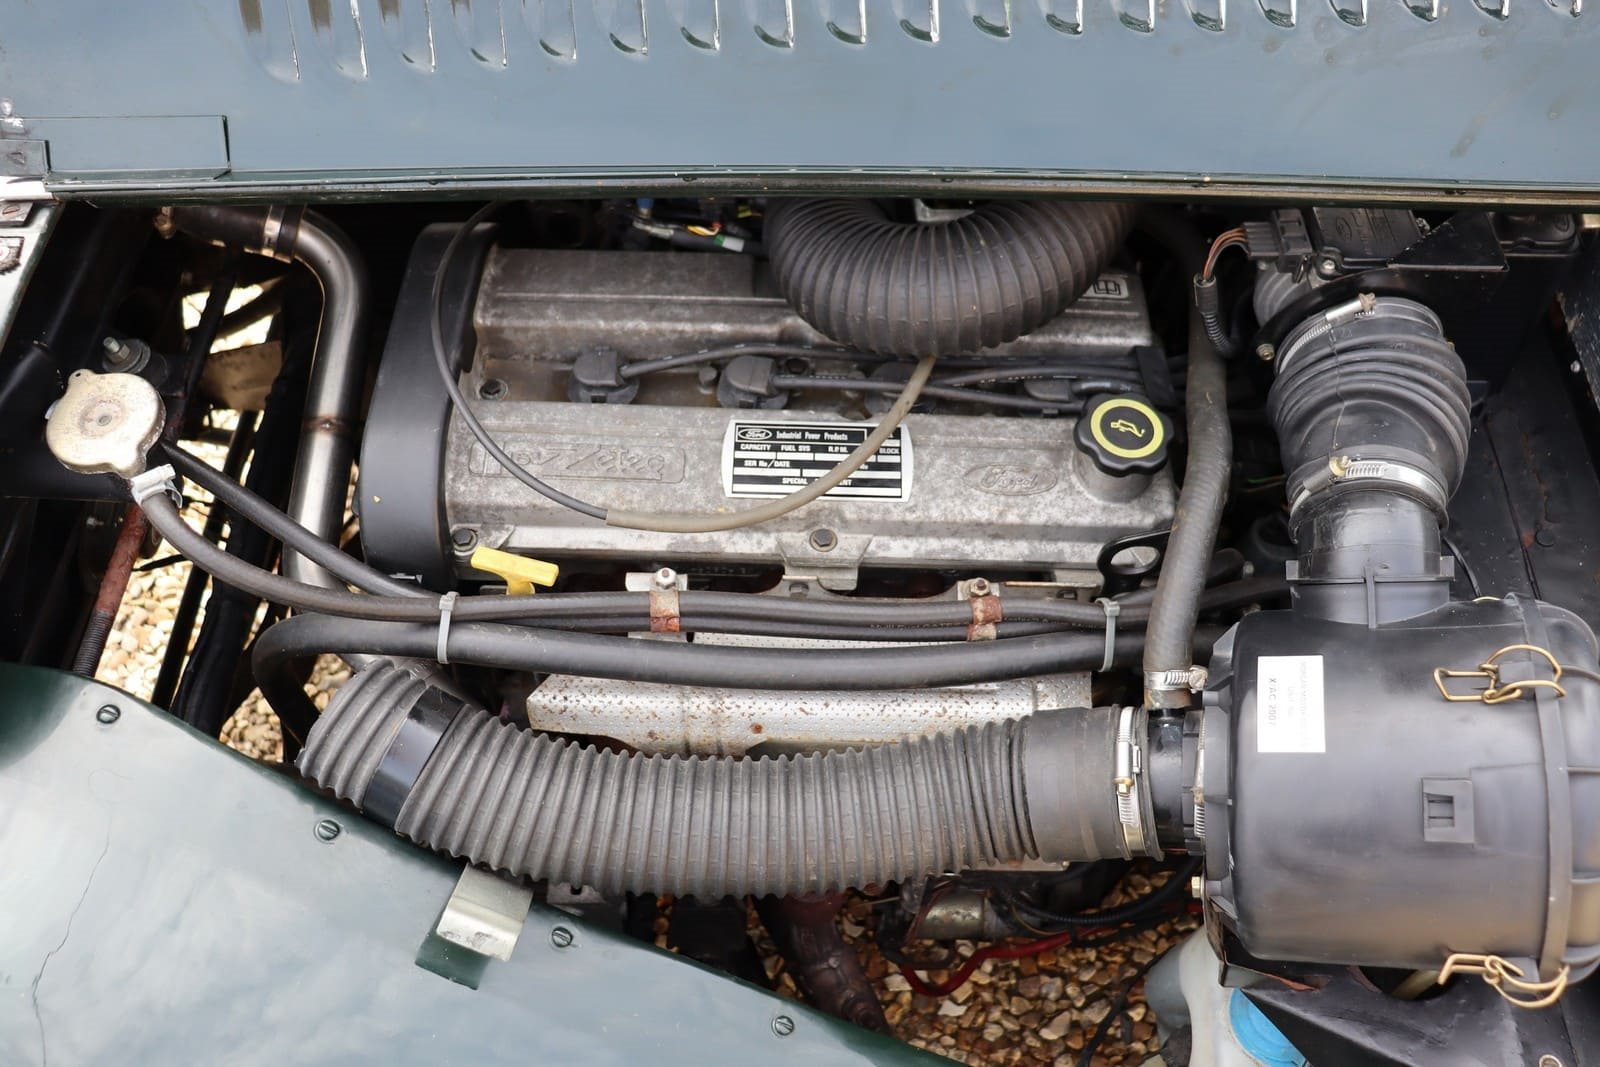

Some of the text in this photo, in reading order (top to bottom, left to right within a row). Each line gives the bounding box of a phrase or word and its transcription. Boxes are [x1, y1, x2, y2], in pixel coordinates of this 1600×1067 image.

[776, 431, 801, 439] Industrial
[804, 432, 821, 440] Power
[823, 432, 848, 441] Products
[782, 477, 808, 485] SPECIAL
